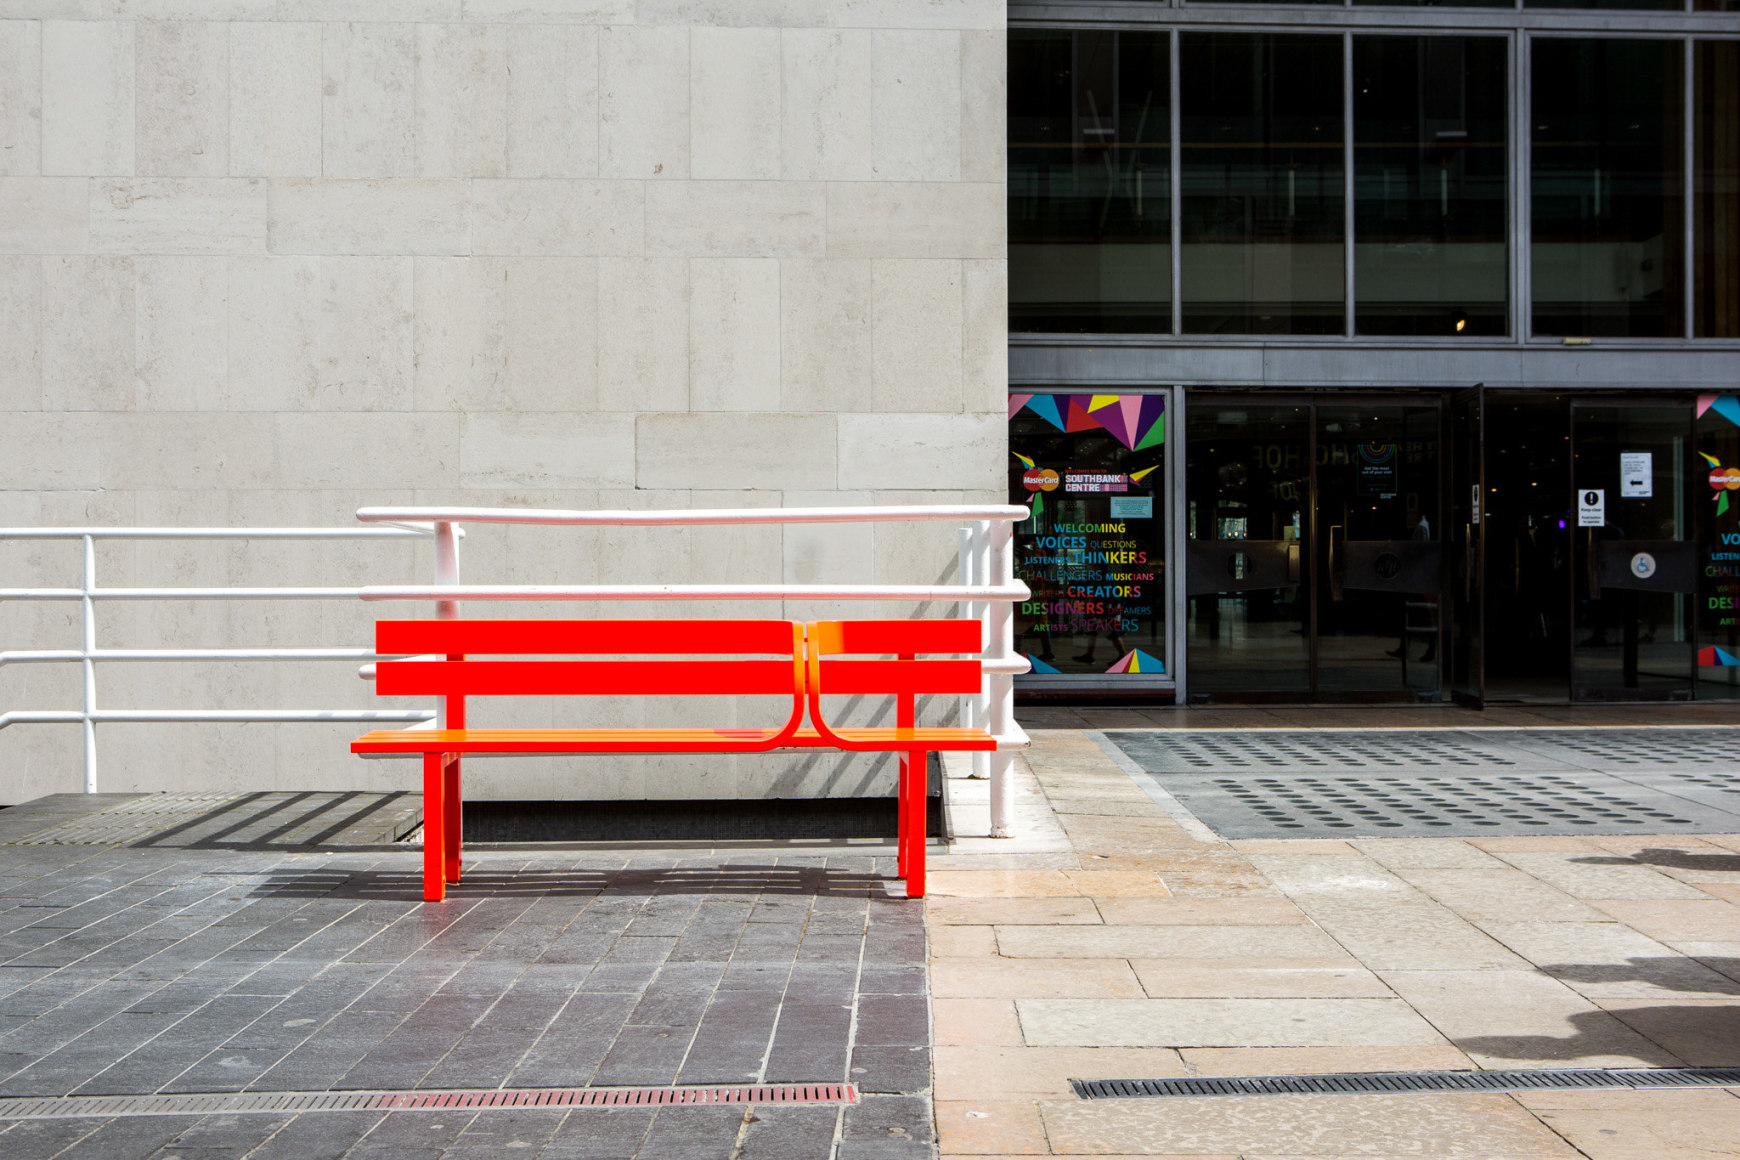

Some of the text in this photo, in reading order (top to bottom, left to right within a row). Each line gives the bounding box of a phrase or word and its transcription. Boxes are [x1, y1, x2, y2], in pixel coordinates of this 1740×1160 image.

[1023, 476, 1059, 484] MasterCard
[1065, 474, 1121, 483] SOUTHBANK
[1065, 483, 1100, 492] CENTRE
[1054, 523, 1126, 533] WELCOMING
[1036, 536, 1137, 549] VOICES QUESTIONS
[1025, 551, 1147, 565] LISTENERS THINKERS
[1019, 570, 1154, 581] CHALLENGERS MUSICIANS
[1067, 585, 1141, 598] CREATORS
[1021, 602, 1151, 615] DESIGNERS DREAMERS
[1033, 618, 1139, 632] ARTISTS SPEAKERS
